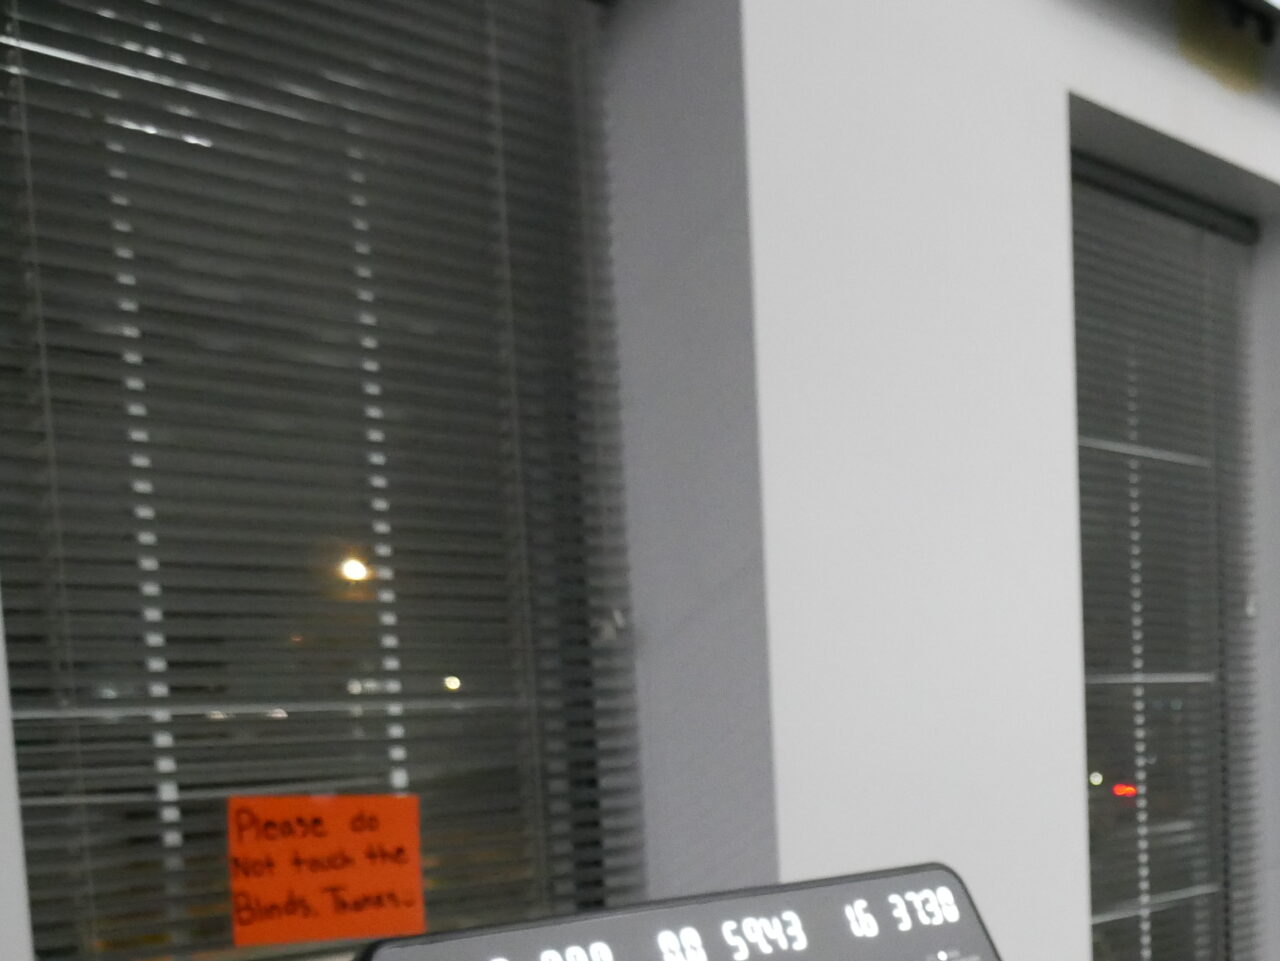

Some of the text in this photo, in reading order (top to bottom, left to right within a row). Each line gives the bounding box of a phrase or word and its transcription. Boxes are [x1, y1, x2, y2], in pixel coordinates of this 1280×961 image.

[235, 807, 380, 842] Please do
[363, 841, 410, 866] the
